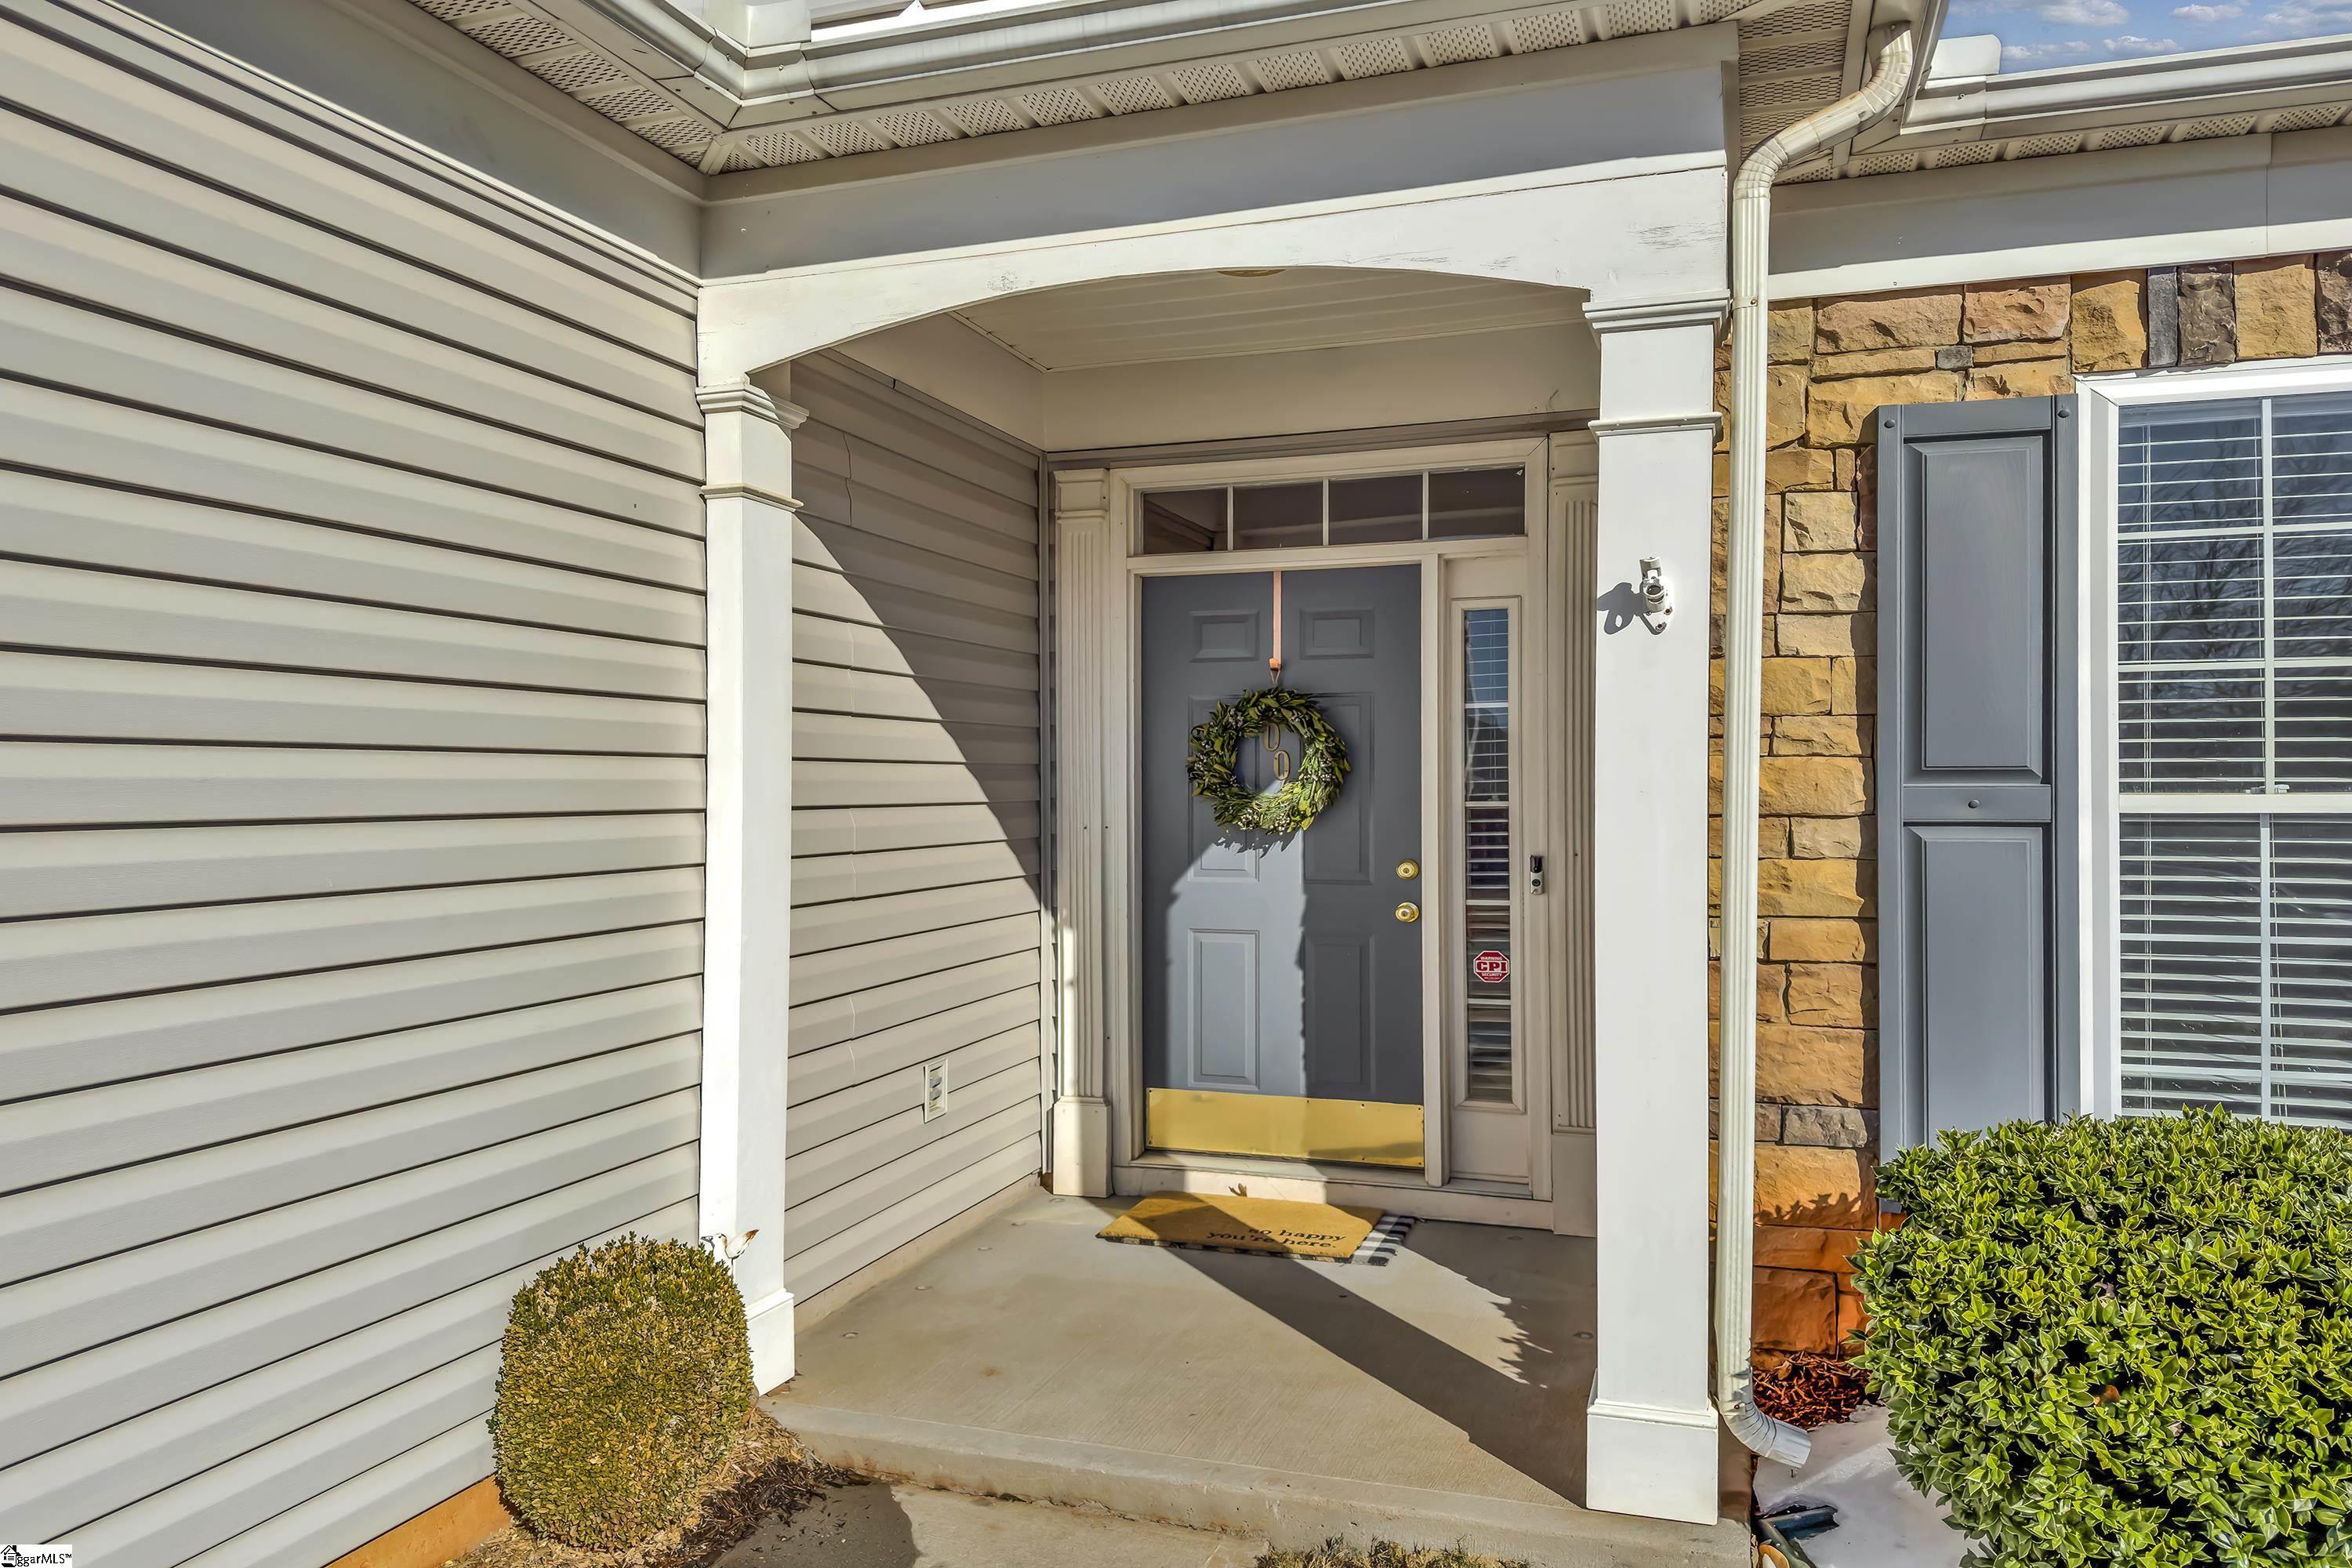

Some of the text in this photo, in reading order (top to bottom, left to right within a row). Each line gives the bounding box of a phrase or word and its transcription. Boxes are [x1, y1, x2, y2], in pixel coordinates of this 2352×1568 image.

[1476, 961, 1507, 971] CPI
[1207, 1231, 1338, 1248] you're here.
[1279, 1229, 1347, 1242] happy
